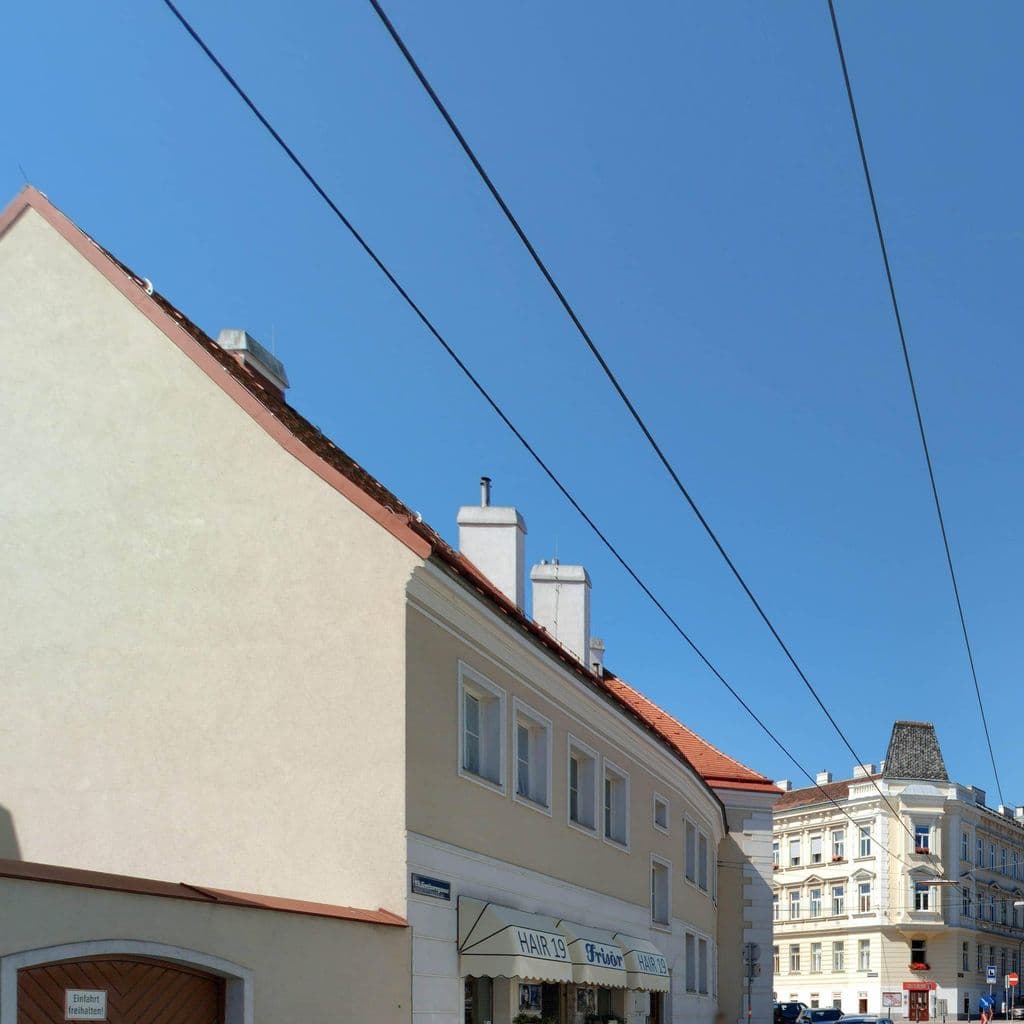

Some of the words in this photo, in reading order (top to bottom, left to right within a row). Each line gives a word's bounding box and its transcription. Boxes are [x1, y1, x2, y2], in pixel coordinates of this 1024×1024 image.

[517, 931, 550, 957] HAIR
[551, 938, 567, 959] 19
[585, 942, 624, 967] Frisör
[637, 953, 657, 973] HAIR
[657, 957, 667, 974] 19
[73, 994, 100, 1004] Einfahrt
